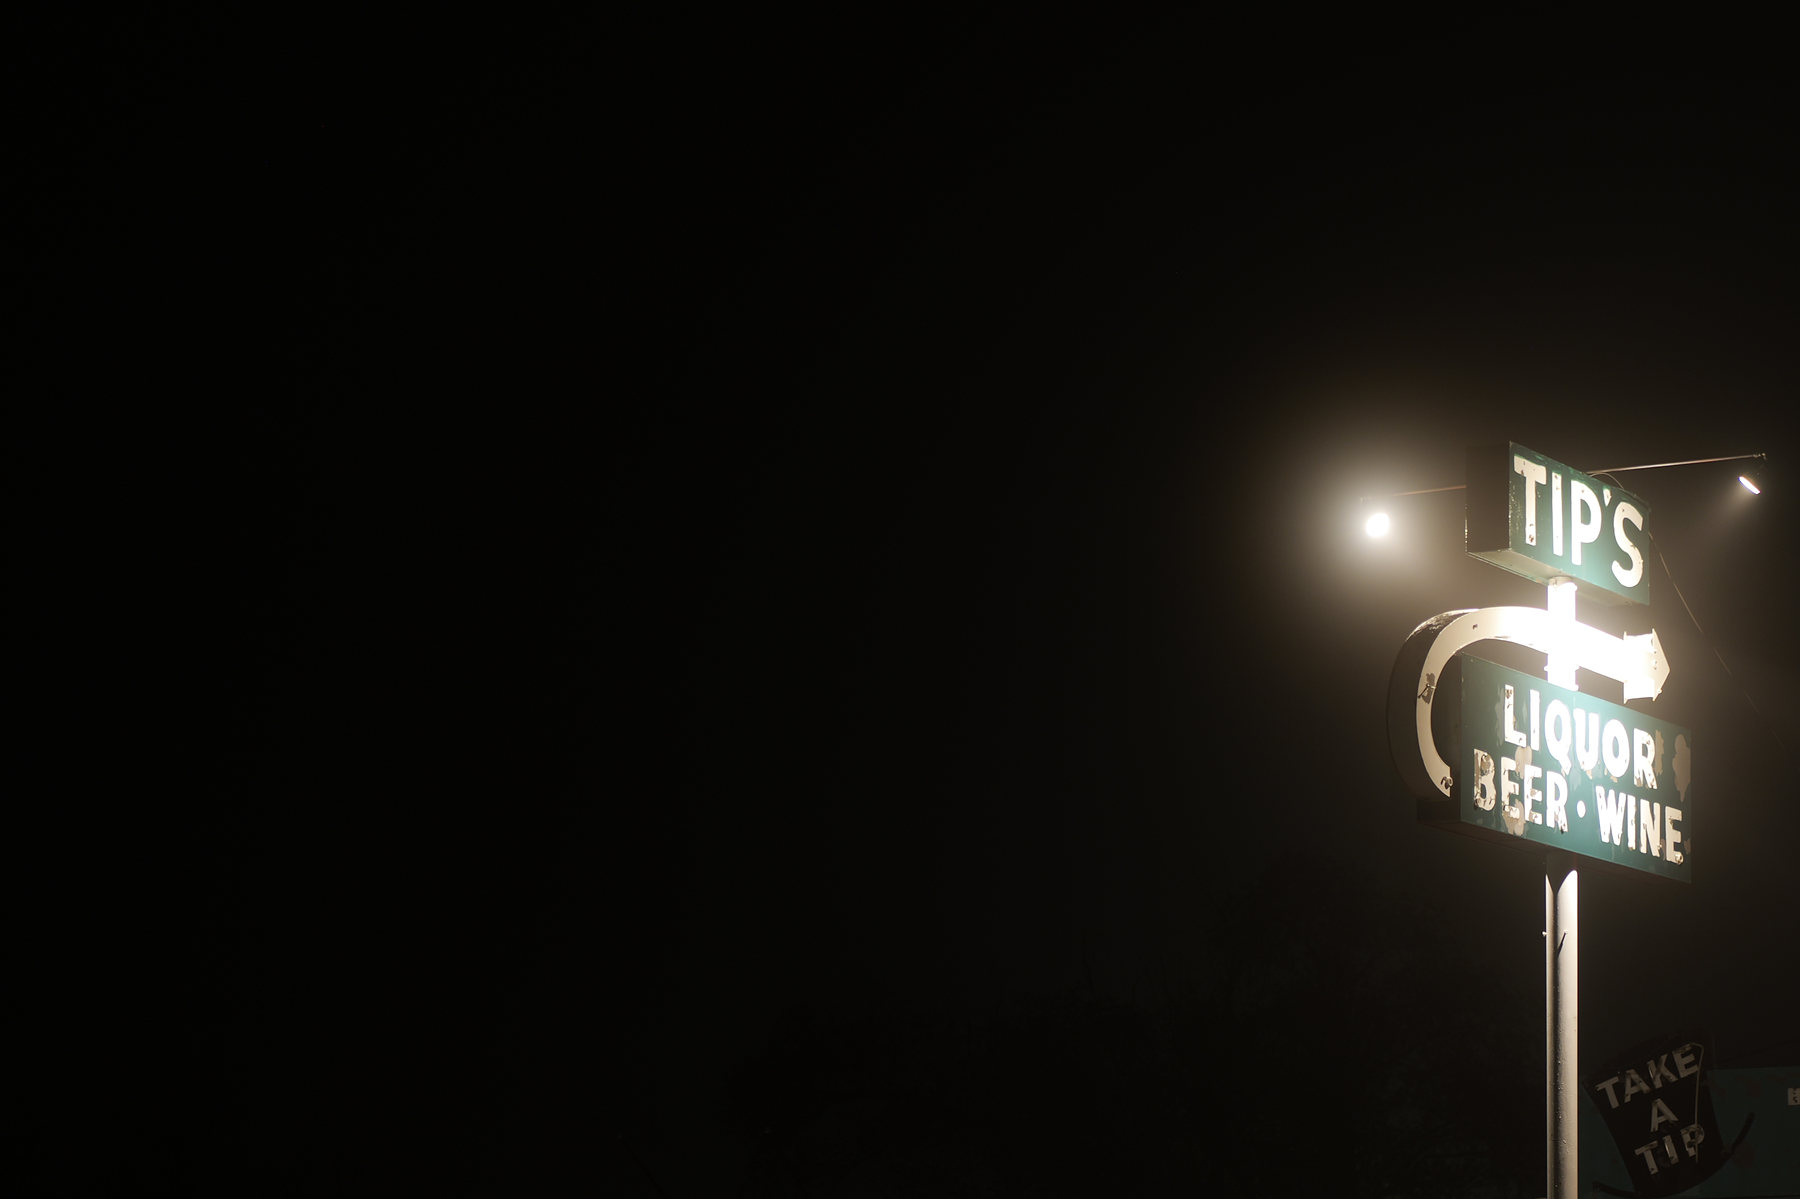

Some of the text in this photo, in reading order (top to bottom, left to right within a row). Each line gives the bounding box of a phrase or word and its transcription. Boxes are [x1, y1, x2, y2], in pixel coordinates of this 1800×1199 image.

[1513, 454, 1645, 589] TIP'S
[1504, 683, 1658, 790] LIQUOR
[1472, 747, 1685, 865] BEER WINE
[1595, 1044, 1700, 1109] TAKE
[1650, 1098, 1680, 1133] A
[1634, 1123, 1705, 1175] TIP
